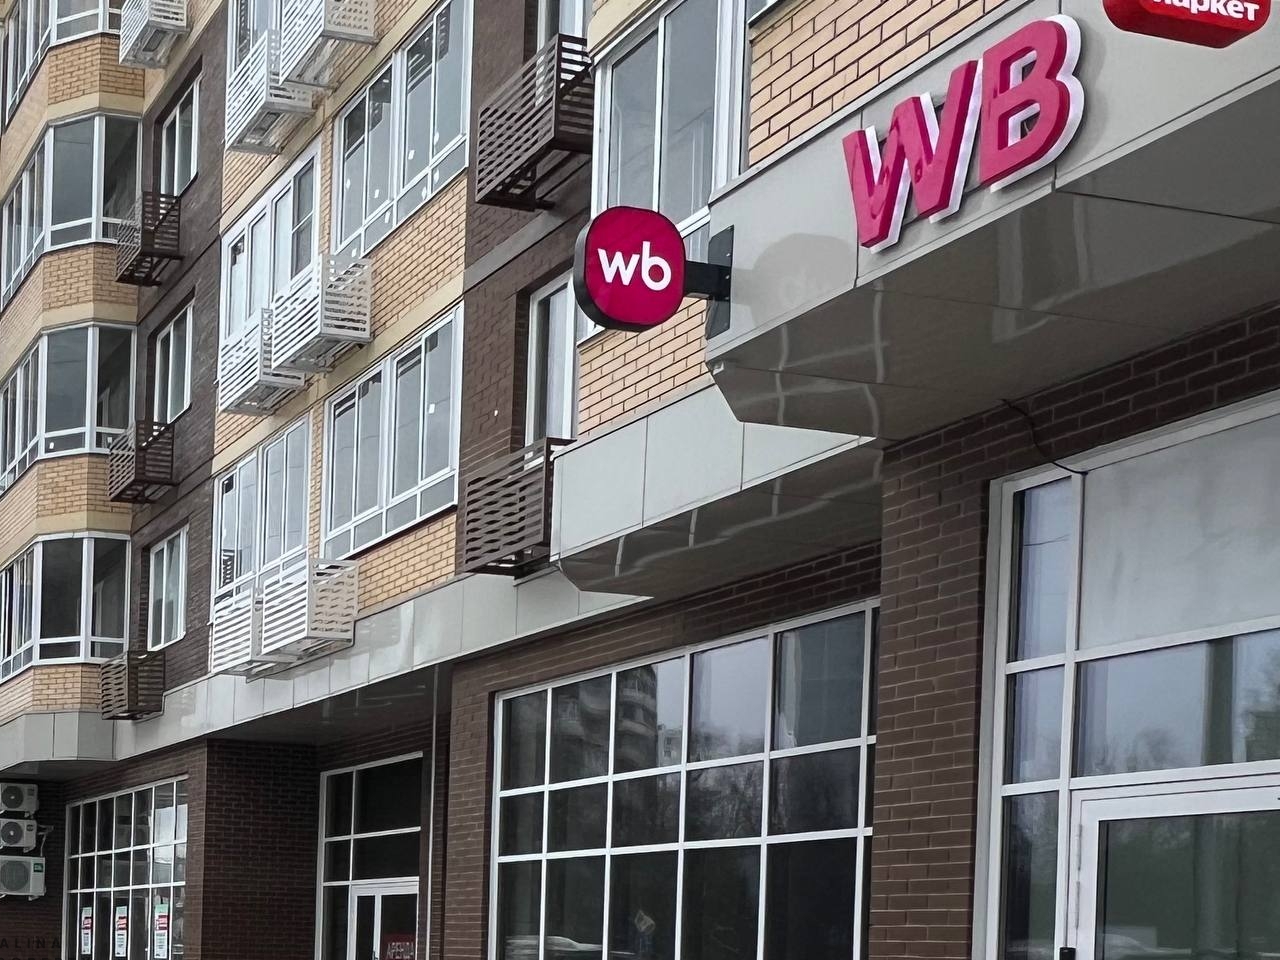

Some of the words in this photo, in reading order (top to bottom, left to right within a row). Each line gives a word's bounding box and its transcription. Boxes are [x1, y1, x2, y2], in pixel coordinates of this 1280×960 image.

[1153, 0, 1260, 21] аркет
[842, 14, 1084, 254] WB
[597, 240, 672, 291] wb
